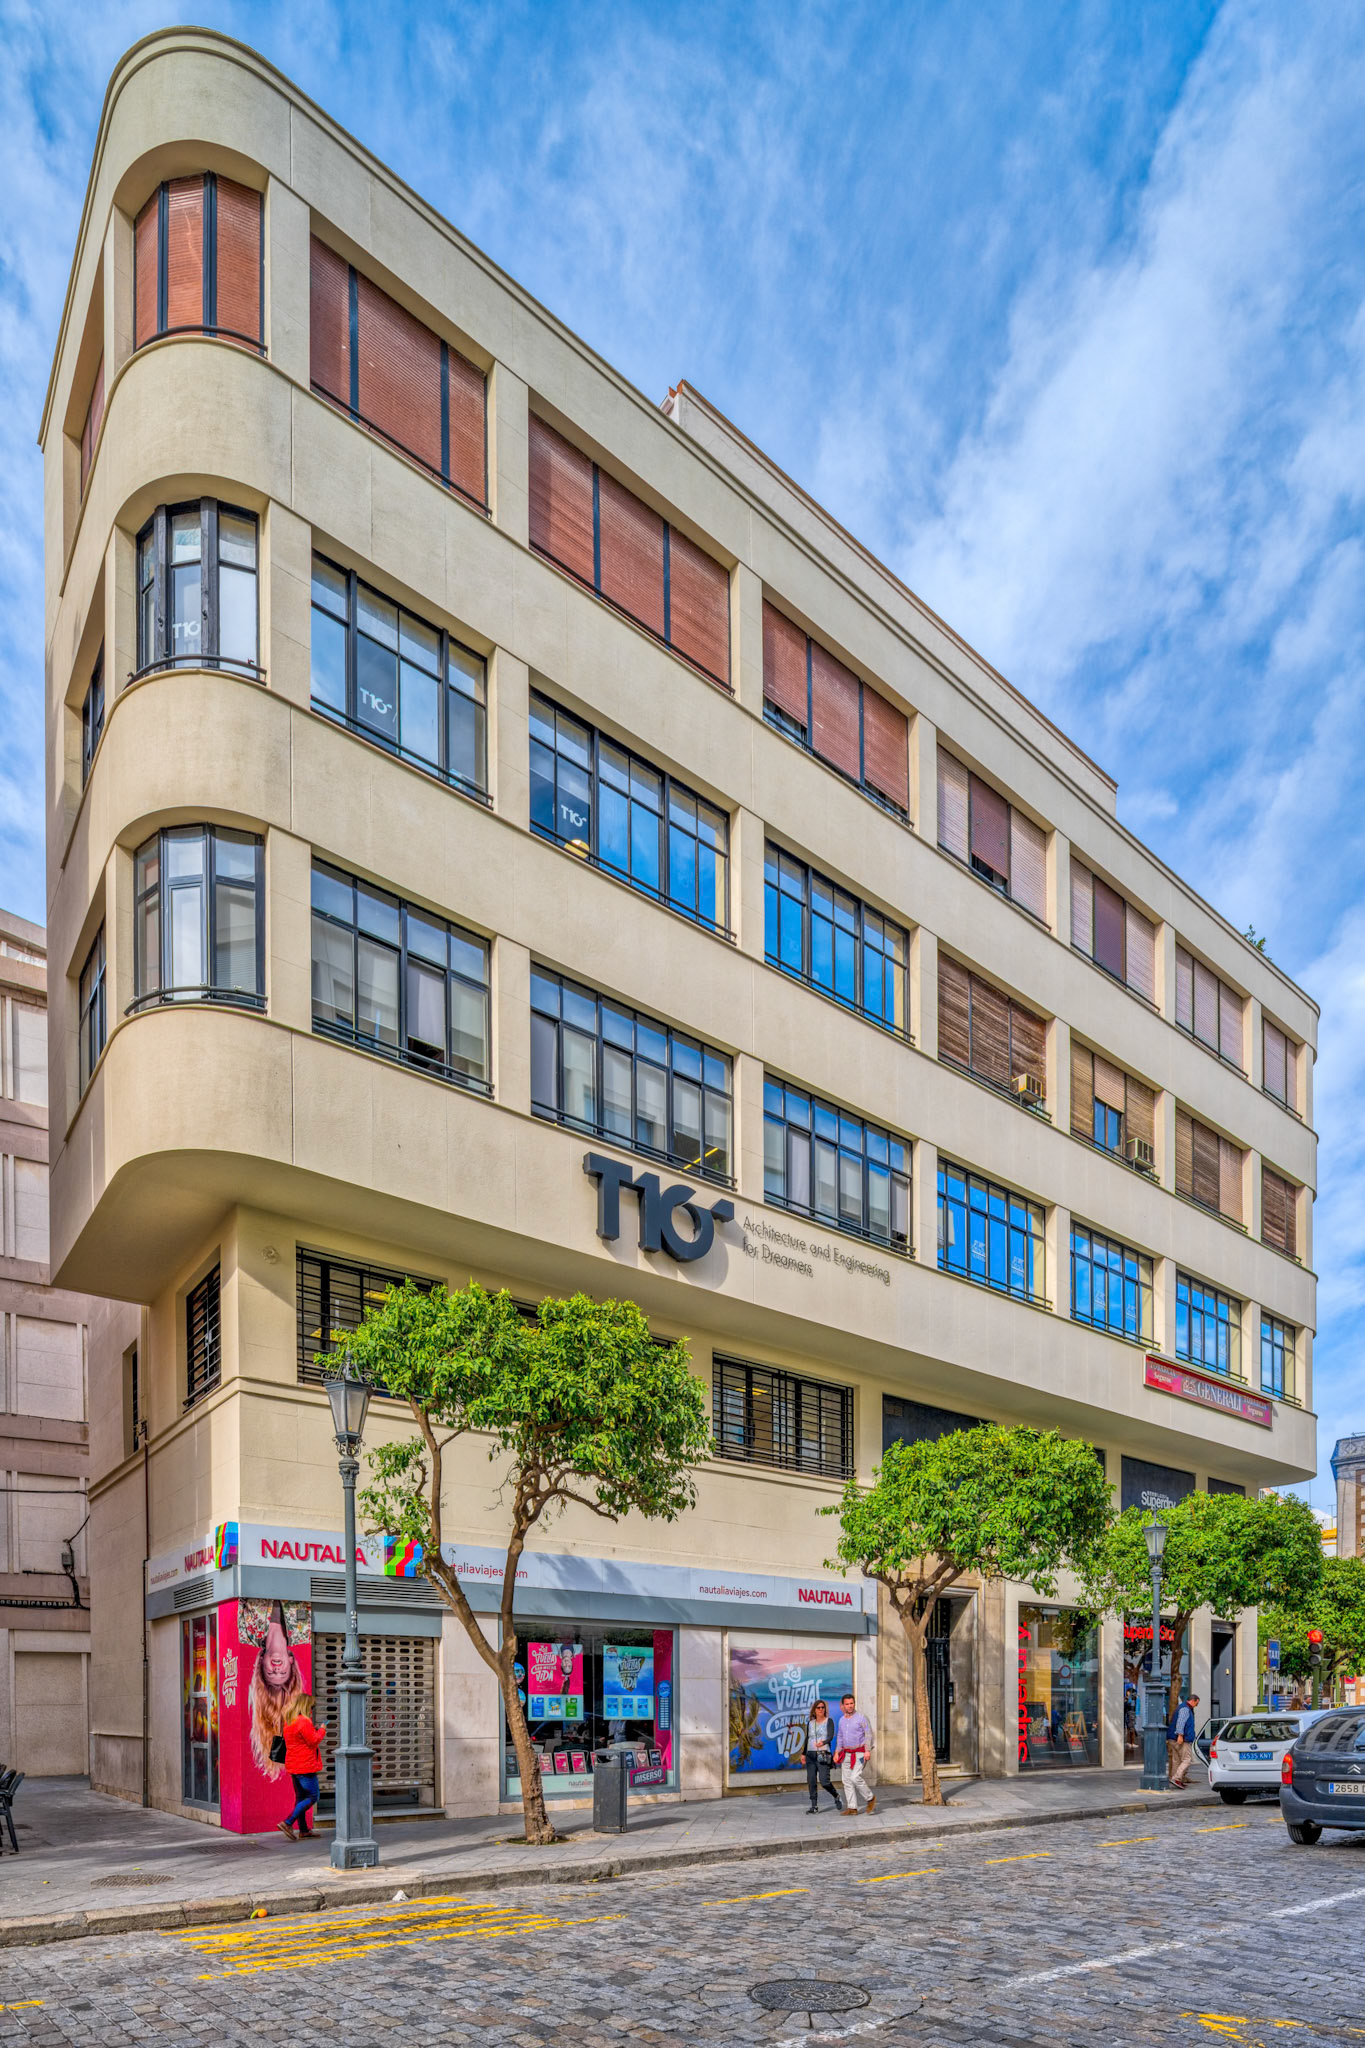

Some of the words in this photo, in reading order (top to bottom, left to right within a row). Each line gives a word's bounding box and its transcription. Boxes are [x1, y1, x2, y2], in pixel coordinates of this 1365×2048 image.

[743, 1216, 807, 1254] Architecture
[809, 1243, 831, 1262] and
[833, 1247, 891, 1286] Engineering
[743, 1235, 759, 1260] for
[762, 1243, 814, 1278] Dreamers
[1197, 1381, 1242, 1412] GENERALI
[1141, 1491, 1177, 1511] Superdry
[184, 1545, 215, 1574] NAUTALIA
[261, 1539, 368, 1566] NAUTALA
[699, 1585, 768, 1599] nautaliaviajes.com
[798, 1588, 853, 1606] NAUTALIA
[1269, 1649, 1280, 1659] TAXI
[774, 1714, 791, 1729] DAN
[792, 1714, 810, 1726] MUC
[1260, 1752, 1272, 1760] KNY
[634, 1769, 662, 1785] IMSERSO
[1335, 1784, 1359, 1793] 2658
